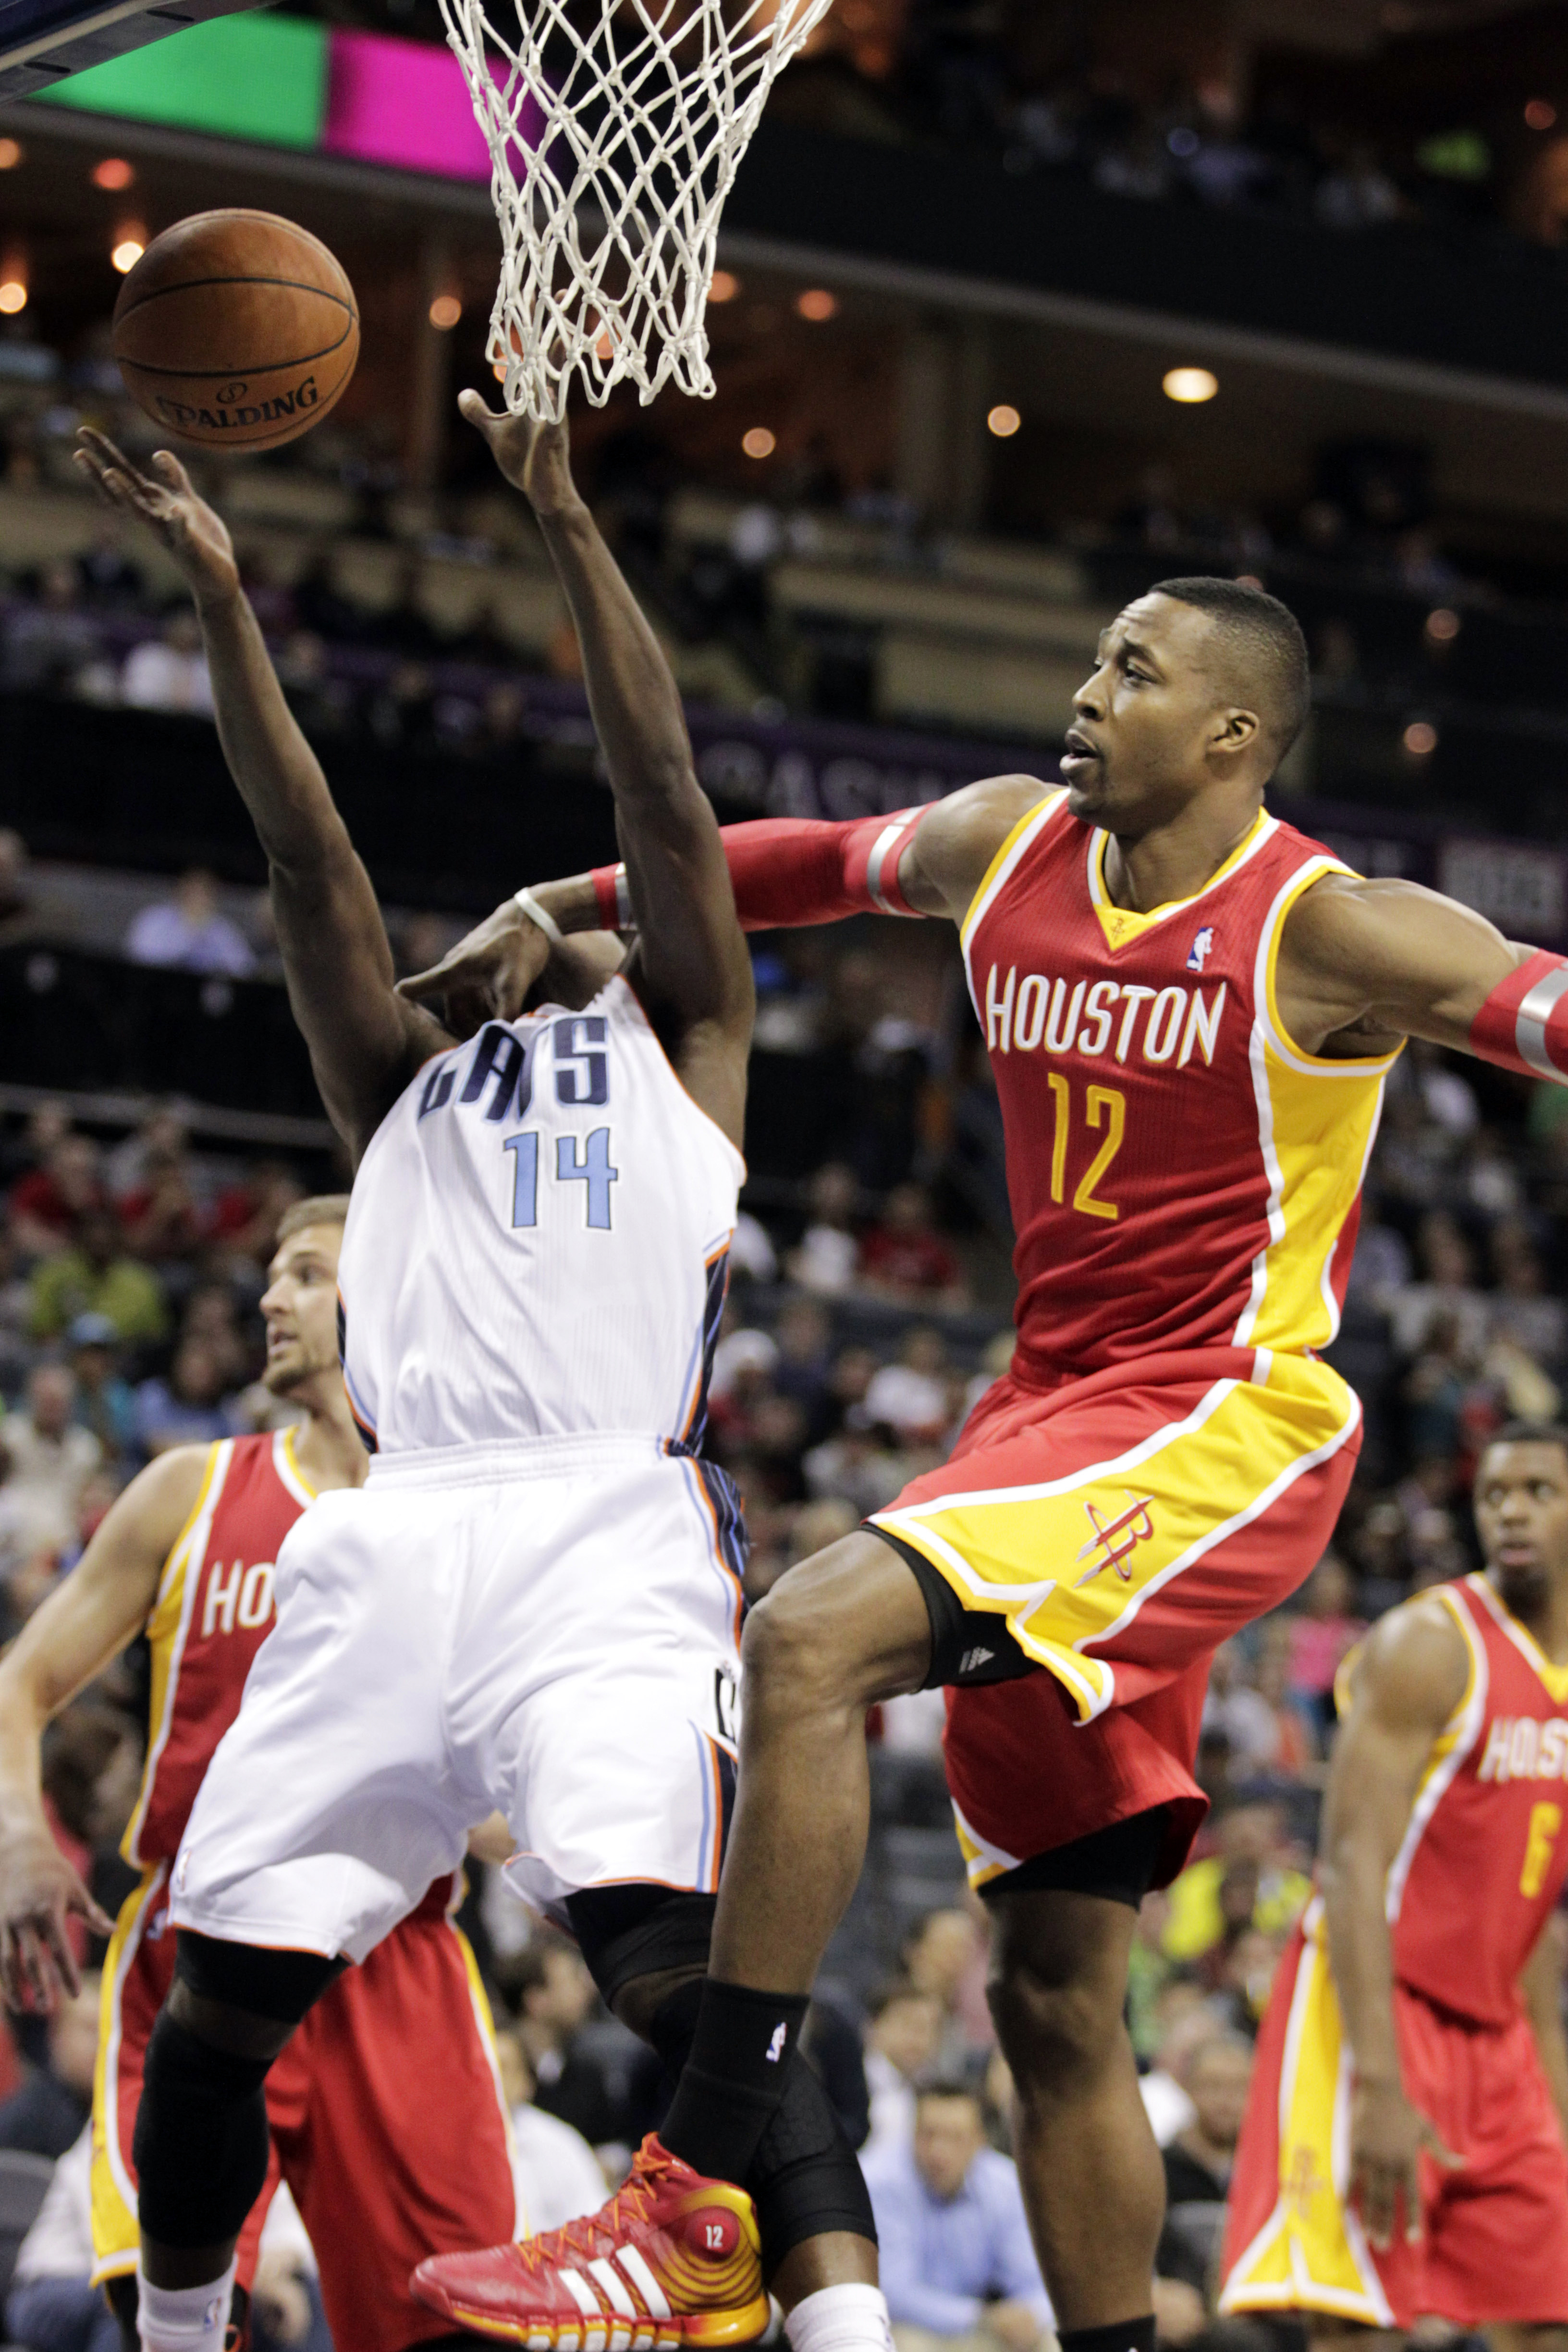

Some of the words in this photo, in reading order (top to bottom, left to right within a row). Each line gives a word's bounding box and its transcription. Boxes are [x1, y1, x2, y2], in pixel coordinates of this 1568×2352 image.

[986, 962, 1226, 1070] HOUSTON
[503, 1127, 618, 1230] 14
[1048, 1071, 1126, 1221] 12
[705, 2225, 723, 2248] 12
